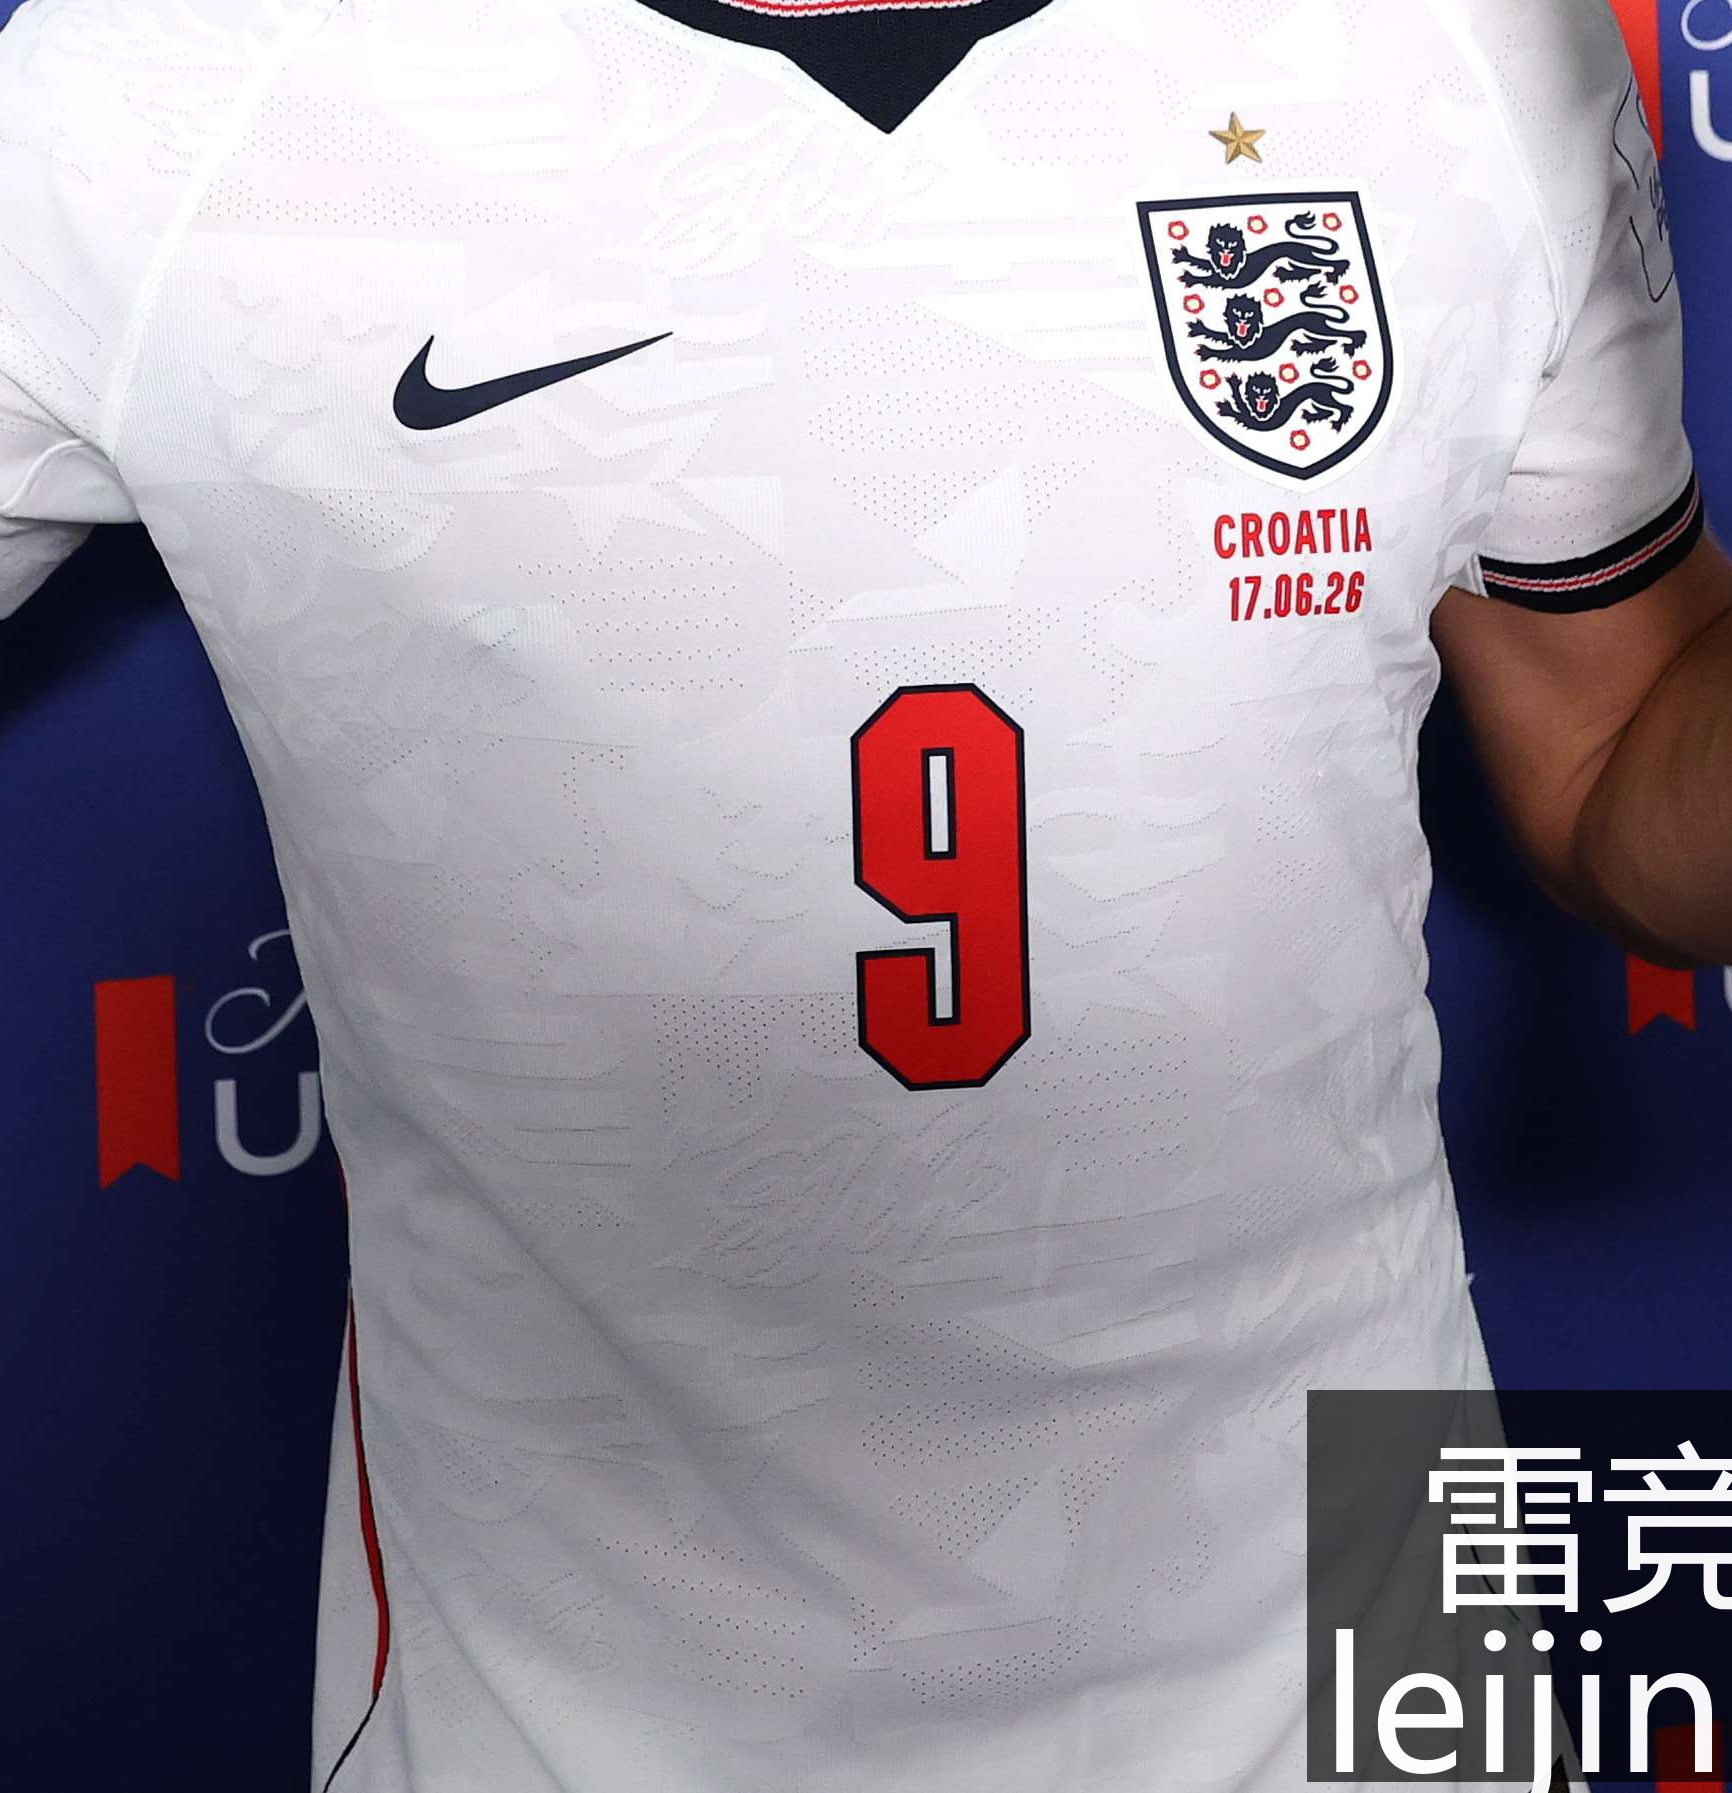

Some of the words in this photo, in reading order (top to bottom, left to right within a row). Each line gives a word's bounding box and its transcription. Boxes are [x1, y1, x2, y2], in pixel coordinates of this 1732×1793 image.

[1214, 507, 1372, 559] CROATIA
[1229, 571, 1364, 621] 17.06.26
[851, 683, 1031, 1090] 9
